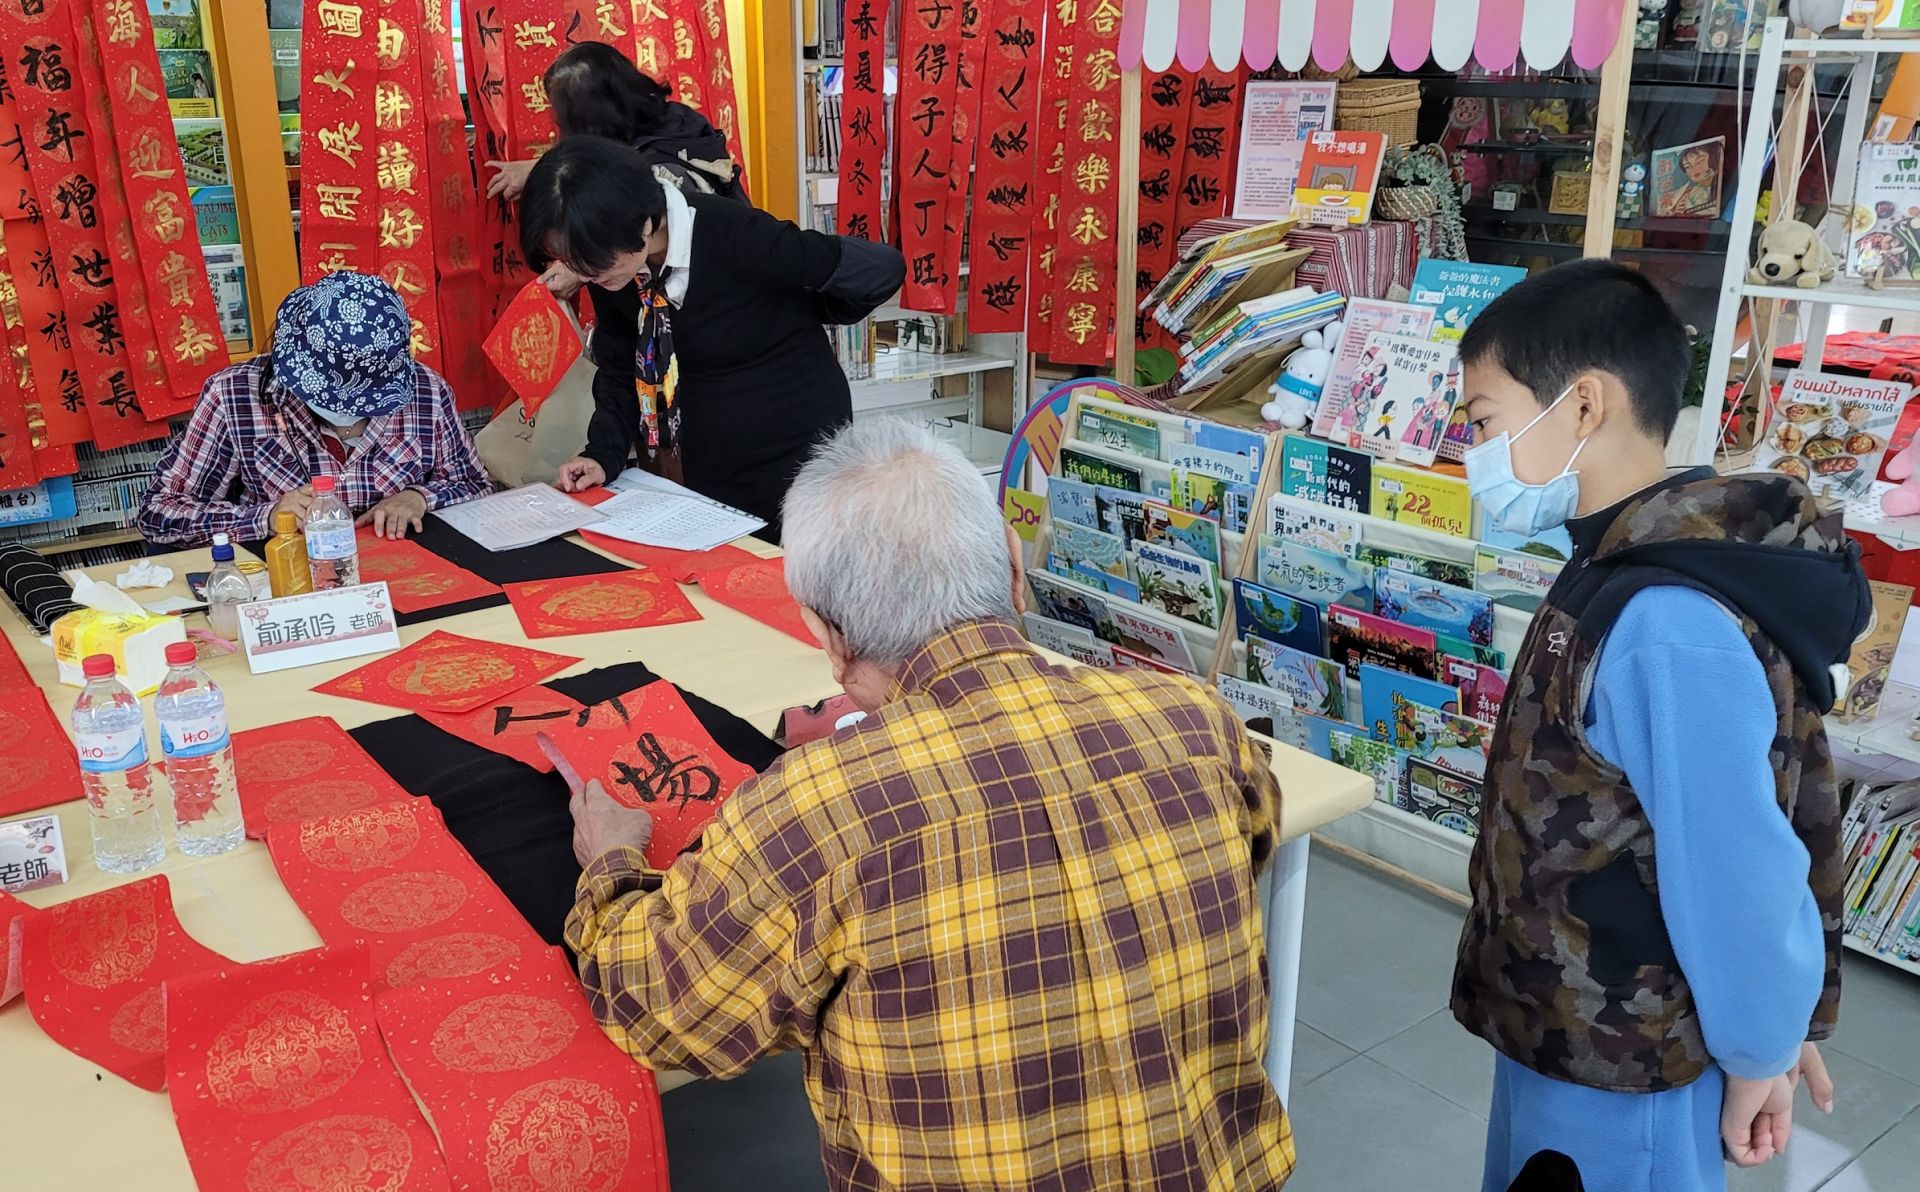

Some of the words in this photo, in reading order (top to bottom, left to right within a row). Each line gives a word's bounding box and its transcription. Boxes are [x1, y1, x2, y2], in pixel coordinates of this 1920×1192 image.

[847, 2, 878, 240] 春夏秋冬福
[1064, 2, 1122, 345] 合家歡樂永康寧
[1274, 505, 1286, 537] 世界
[1402, 491, 1432, 517] 22
[255, 611, 336, 648] 俞承吟
[348, 610, 385, 632] 老師
